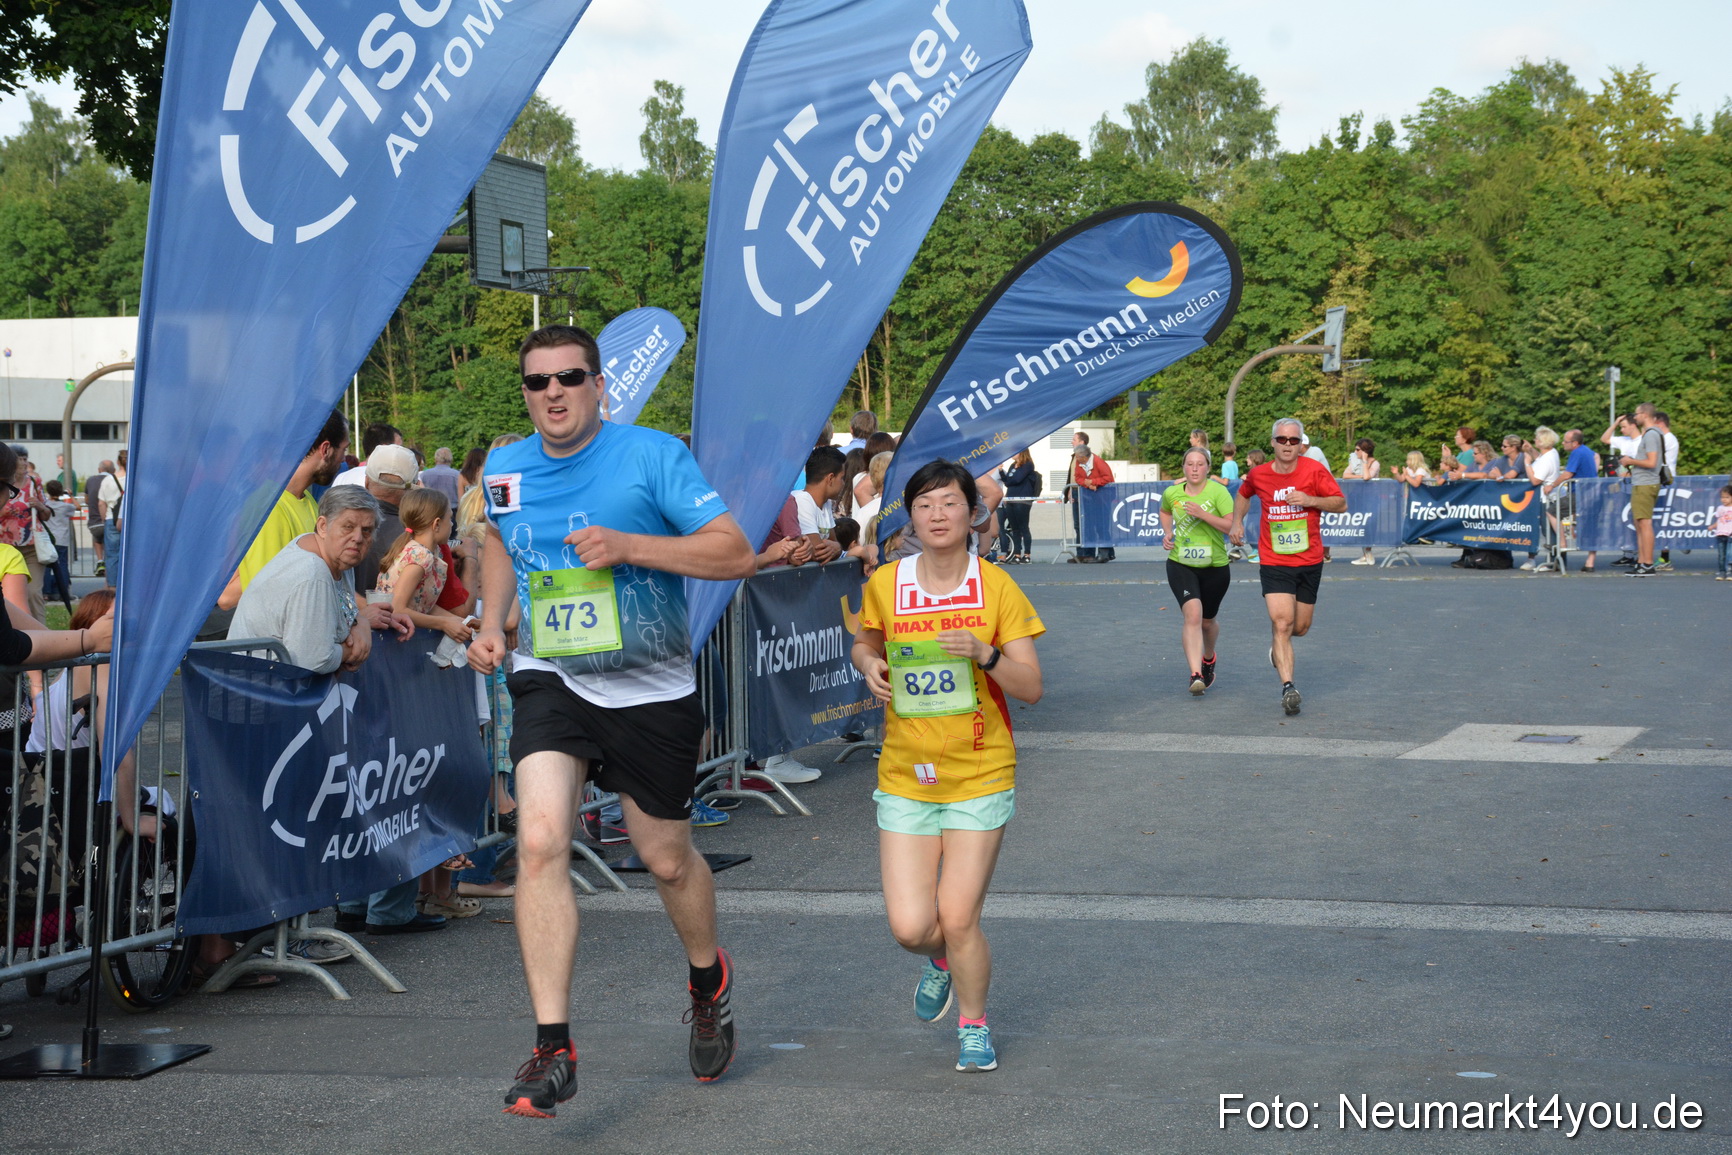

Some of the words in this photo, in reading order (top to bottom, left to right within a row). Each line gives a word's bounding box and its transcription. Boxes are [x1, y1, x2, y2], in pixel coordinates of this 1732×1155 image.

[385, 0, 516, 178] AUTOM
[785, 0, 960, 270] Fischer
[849, 43, 981, 266] AUTOMOBILE
[1074, 341, 1126, 377] Druck
[1126, 322, 1161, 348] und
[1159, 288, 1221, 332] Medien
[608, 324, 663, 402] Fischer
[627, 338, 670, 401] AUTOMOBILE
[937, 303, 1149, 432] Frischmann
[1319, 528, 1366, 537] TOMOBILE
[1410, 501, 1503, 520] Frischmann
[1462, 520, 1486, 530] Druck
[1183, 548, 1206, 559] 202
[1278, 533, 1301, 545] 943
[545, 601, 598, 632] 473
[893, 619, 935, 634] MAX
[940, 613, 987, 630] BÖGL
[756, 621, 844, 676] Frischmann
[809, 667, 830, 693] Druck
[830, 663, 849, 687] und
[904, 669, 956, 696] 828
[306, 737, 446, 823] Fischer
[320, 803, 420, 864] AUTOMOBILE
